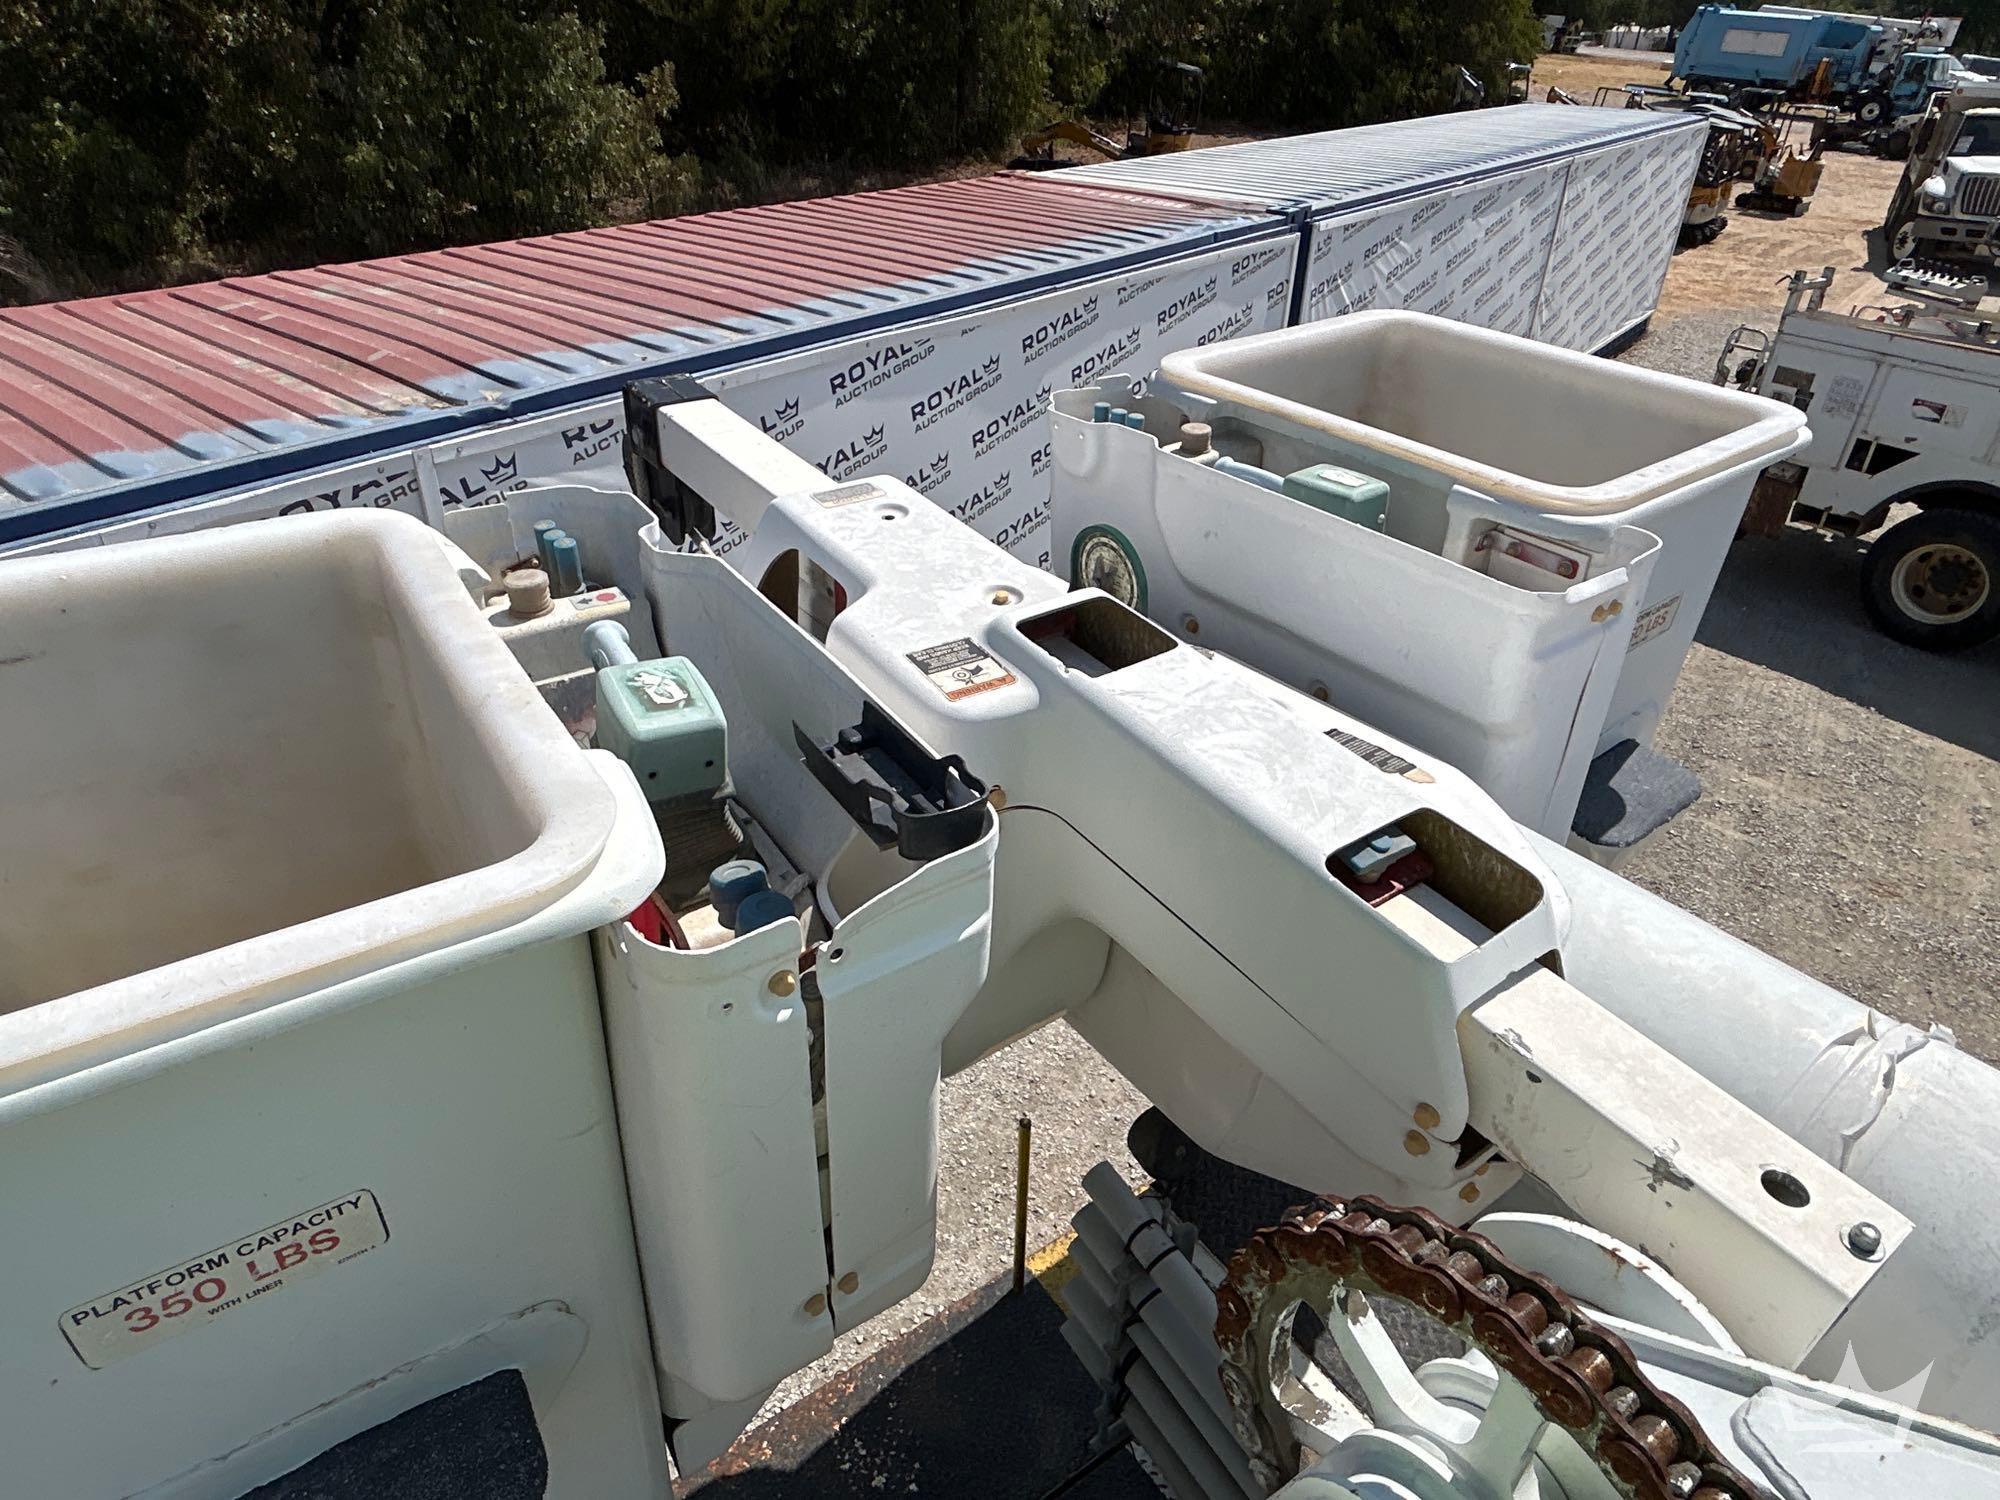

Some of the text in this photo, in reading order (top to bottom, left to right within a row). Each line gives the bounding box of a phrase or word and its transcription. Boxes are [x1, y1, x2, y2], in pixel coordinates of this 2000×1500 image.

[1157, 287, 1204, 327] ROYAL
[1197, 312, 1241, 347] ROYAL
[1022, 307, 1083, 353] ROYAL
[1024, 312, 1099, 366] AUCTION GROUP
[829, 343, 912, 395] ROYAL
[835, 344, 936, 409] AUCTION GROUP
[1071, 338, 1127, 383] ROYAL
[911, 369, 983, 422] ROYAL
[915, 373, 1002, 434] AUCTION GROUP
[972, 398, 1036, 448] ROYAL
[975, 425, 1018, 460] AUCTION
[816, 440, 864, 476] YAL
[844, 444, 888, 477] GROUP
[921, 470, 951, 496] ROUP
[978, 488, 1012, 516] GROUP
[994, 506, 1043, 545] OYAL
[71, 1195, 362, 1326] PLATFORM CAPACITY
[124, 1228, 340, 1333] 350 LBS
[207, 1278, 284, 1316] WITH LINER
